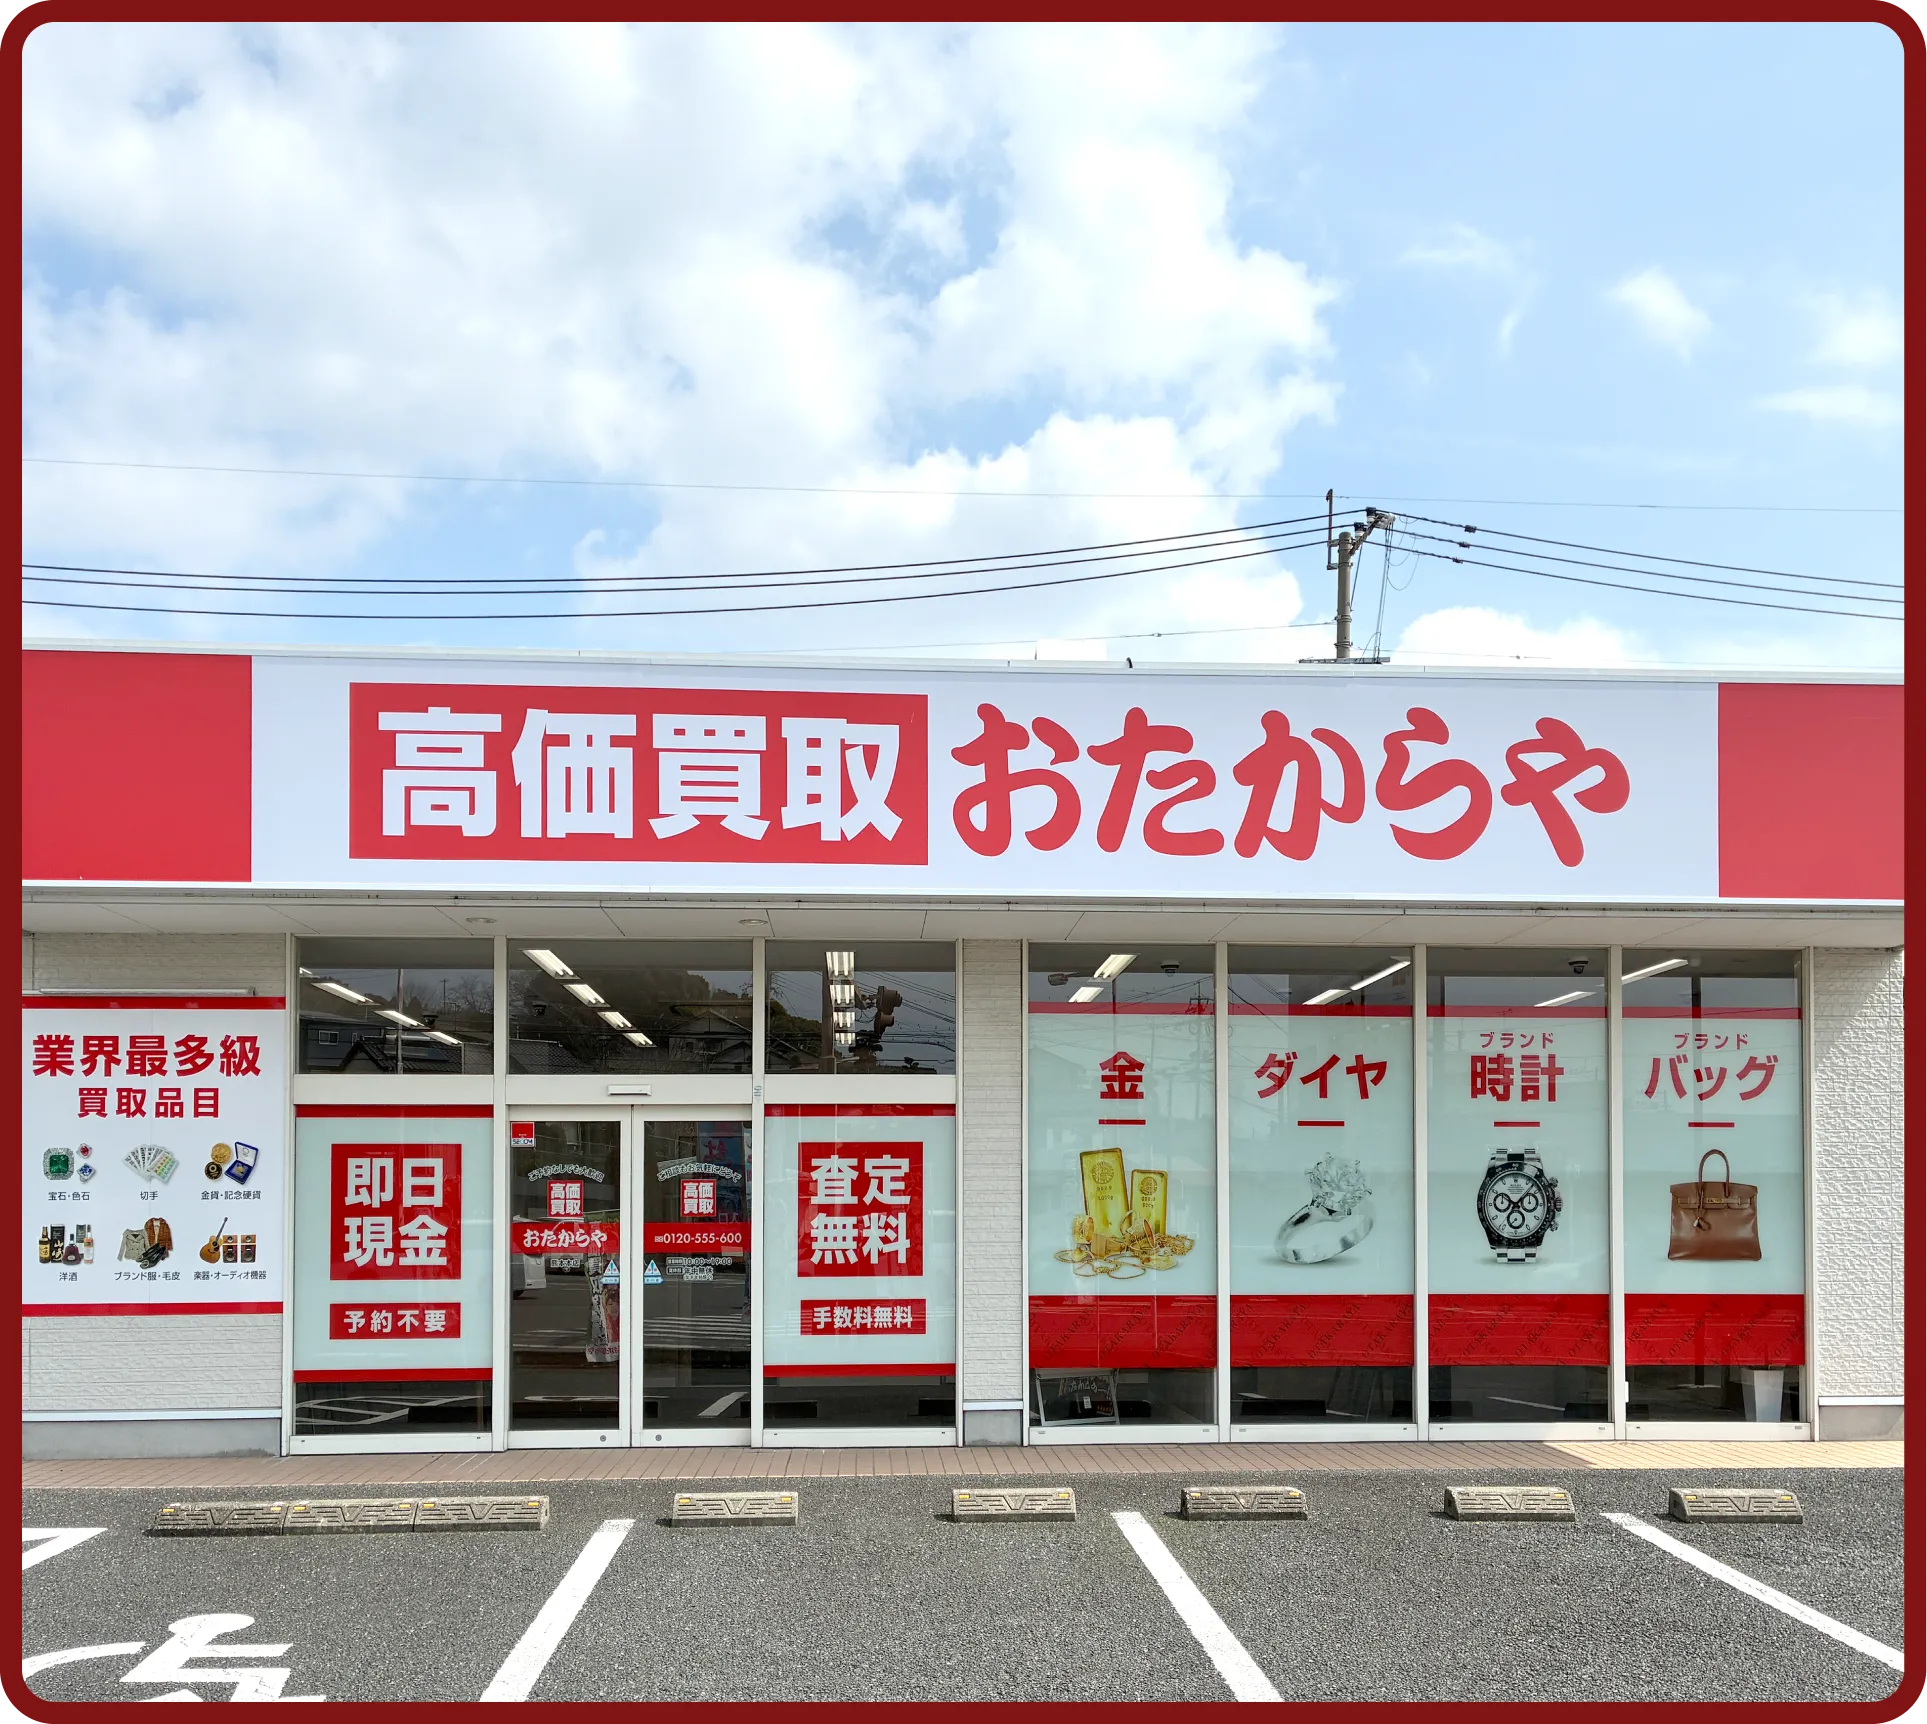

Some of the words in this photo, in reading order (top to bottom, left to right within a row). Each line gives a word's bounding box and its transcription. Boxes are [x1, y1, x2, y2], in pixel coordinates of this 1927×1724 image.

[378, 706, 901, 843] 高価買取
[951, 702, 1631, 868] おたからや
[1480, 1033, 1554, 1049] ブランド
[1674, 1033, 1748, 1049] ブランド
[33, 1035, 261, 1077] 業界最多級
[1099, 1051, 1146, 1100] 金
[1254, 1051, 1388, 1100] ダイヤ
[1470, 1053, 1564, 1102] 時計
[1645, 1055, 1778, 1101] バッグ
[78, 1088, 219, 1119] 買取品目
[344, 1157, 444, 1208] 即日
[683, 1182, 714, 1198] 高価
[810, 1155, 911, 1205] 査定
[48, 1191, 90, 1201] 宝石・色石
[140, 1191, 159, 1200] 切手
[201, 1190, 261, 1200] 金貨・記念硬貨
[550, 1183, 581, 1199] 高価
[550, 1200, 581, 1215] 買取
[683, 1199, 714, 1214] 買取
[343, 1215, 448, 1268] 現金
[523, 1229, 608, 1248] おたからや
[663, 1233, 742, 1244] 0120-555-600
[810, 1213, 911, 1265] 無料
[59, 1272, 78, 1281] 洋酒
[114, 1271, 181, 1281] ブランド服・毛皮
[193, 1270, 267, 1280] 楽器・オーディオ機器
[344, 1310, 446, 1335] 予約不要
[813, 1306, 913, 1329] 手数料無料
